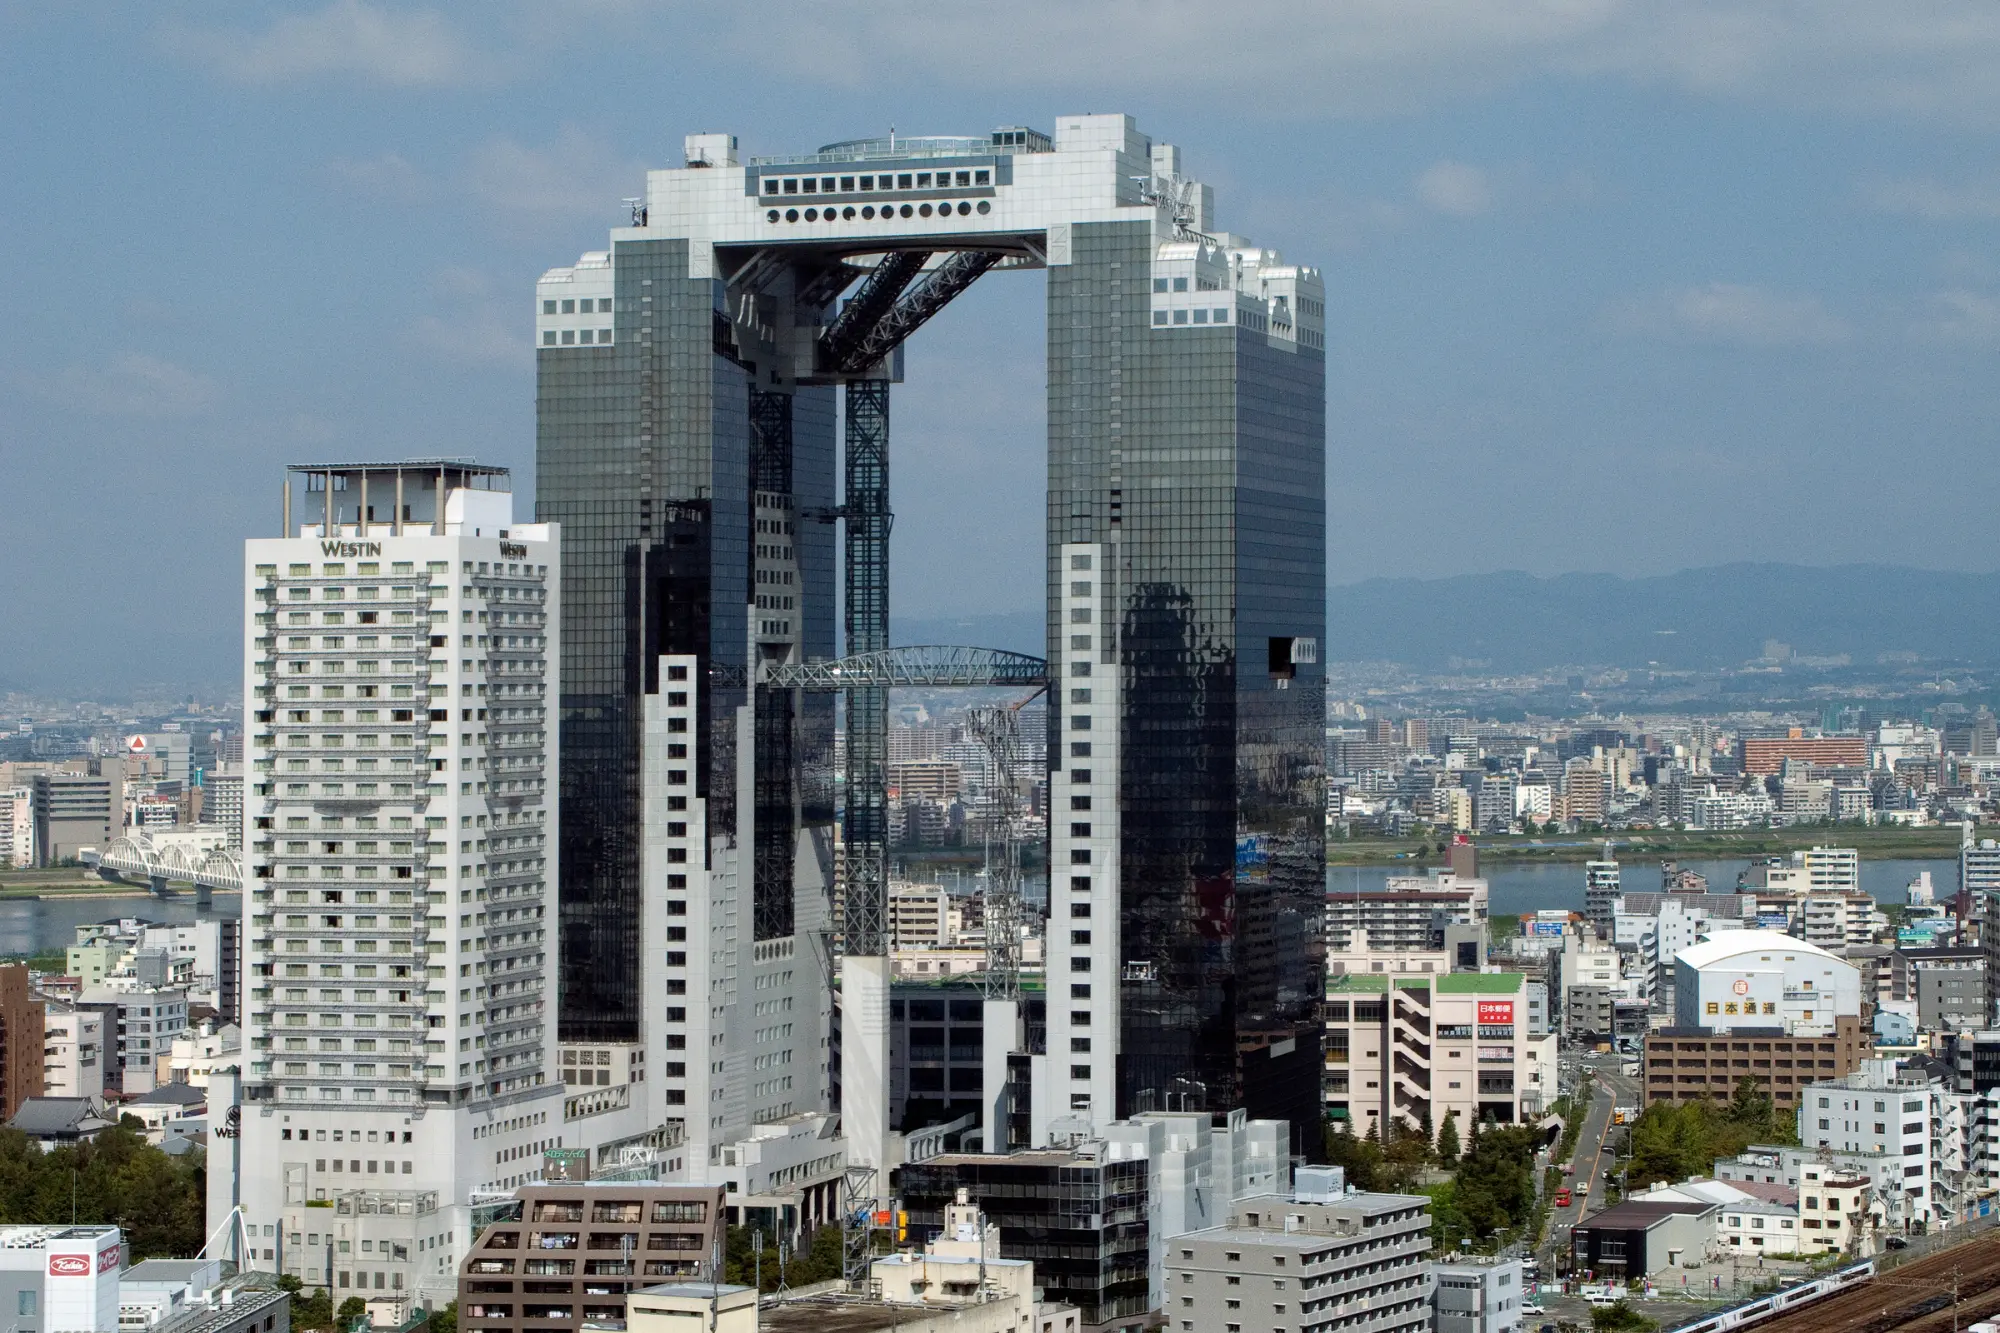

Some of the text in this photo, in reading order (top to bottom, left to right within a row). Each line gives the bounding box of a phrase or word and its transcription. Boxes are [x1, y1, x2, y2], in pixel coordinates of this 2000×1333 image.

[321, 541, 381, 557] WESTIN
[1706, 1002, 1776, 1014] 日本通運
